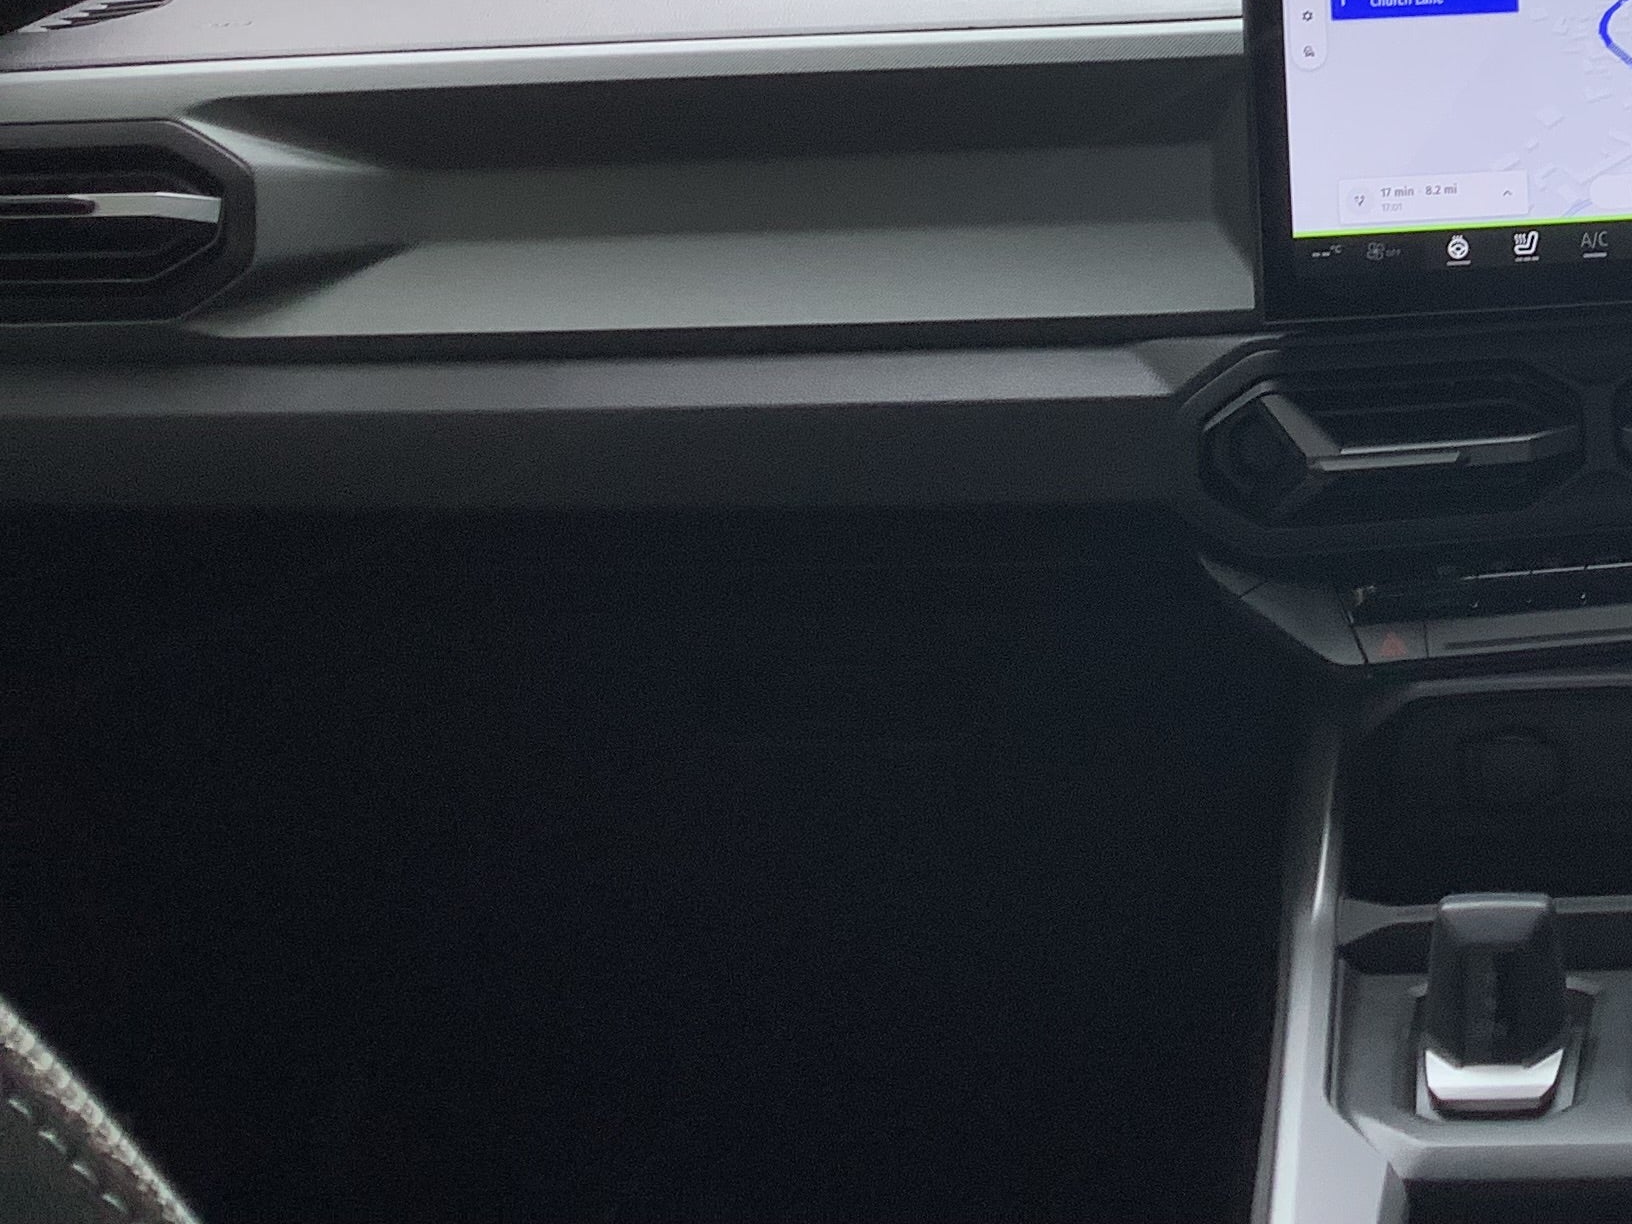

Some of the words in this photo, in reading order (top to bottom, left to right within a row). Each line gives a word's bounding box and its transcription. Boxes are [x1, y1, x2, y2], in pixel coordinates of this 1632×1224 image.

[1380, 187, 1391, 198] 17
[1394, 186, 1414, 197] min
[1425, 185, 1441, 196] 8.2
[1444, 183, 1457, 194] mi
[1581, 231, 1608, 248] A/C
